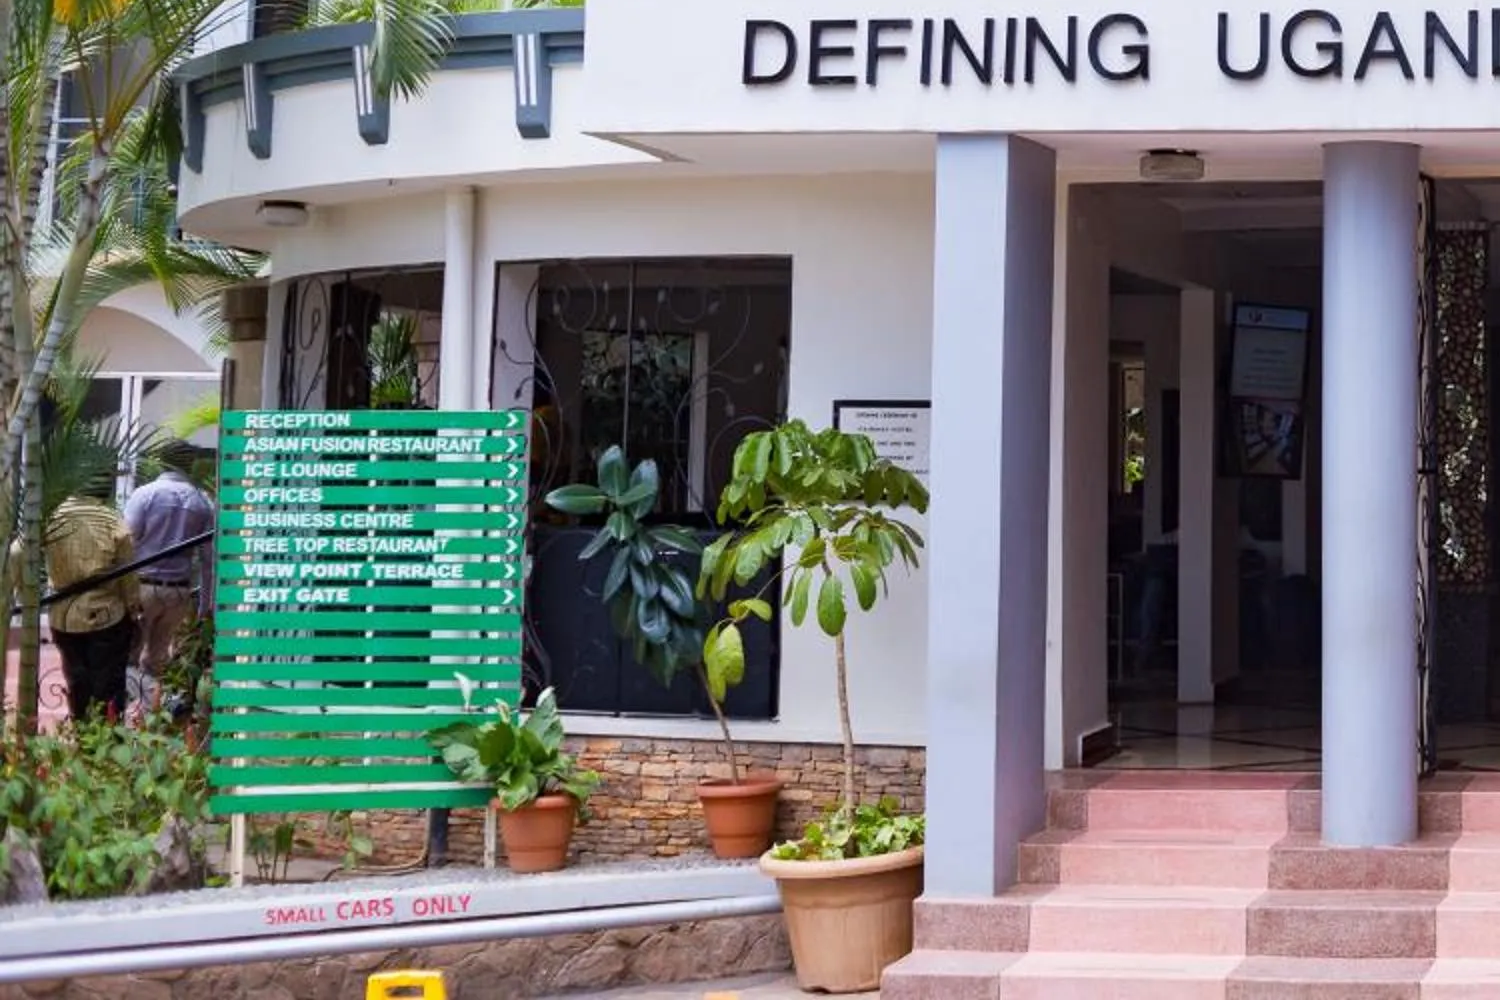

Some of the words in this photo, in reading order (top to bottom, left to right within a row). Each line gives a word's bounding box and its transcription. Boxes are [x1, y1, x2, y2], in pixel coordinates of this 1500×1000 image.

[742, 13, 1151, 87] DEFINING
[244, 413, 351, 429] RECEPTION
[244, 437, 299, 452] ASIAN
[301, 437, 365, 452] FUSION
[367, 437, 483, 453] RESTAURANT
[244, 463, 276, 477] ICE
[281, 463, 358, 477] LOUNGE
[243, 488, 323, 503] OFFICES
[243, 513, 336, 528] BUSINESS
[340, 513, 414, 528] CENTRE
[243, 538, 289, 553] TREE
[293, 538, 329, 553] TOP
[332, 538, 449, 553] RESTAURANT
[242, 563, 297, 578] VIEW
[300, 563, 363, 578] POINT
[371, 563, 464, 579] TERRACE
[243, 588, 292, 603] EXIT
[295, 588, 350, 603] GATE
[264, 907, 326, 925] SMALL
[336, 897, 395, 921] CARS
[412, 895, 471, 917] ONLY
